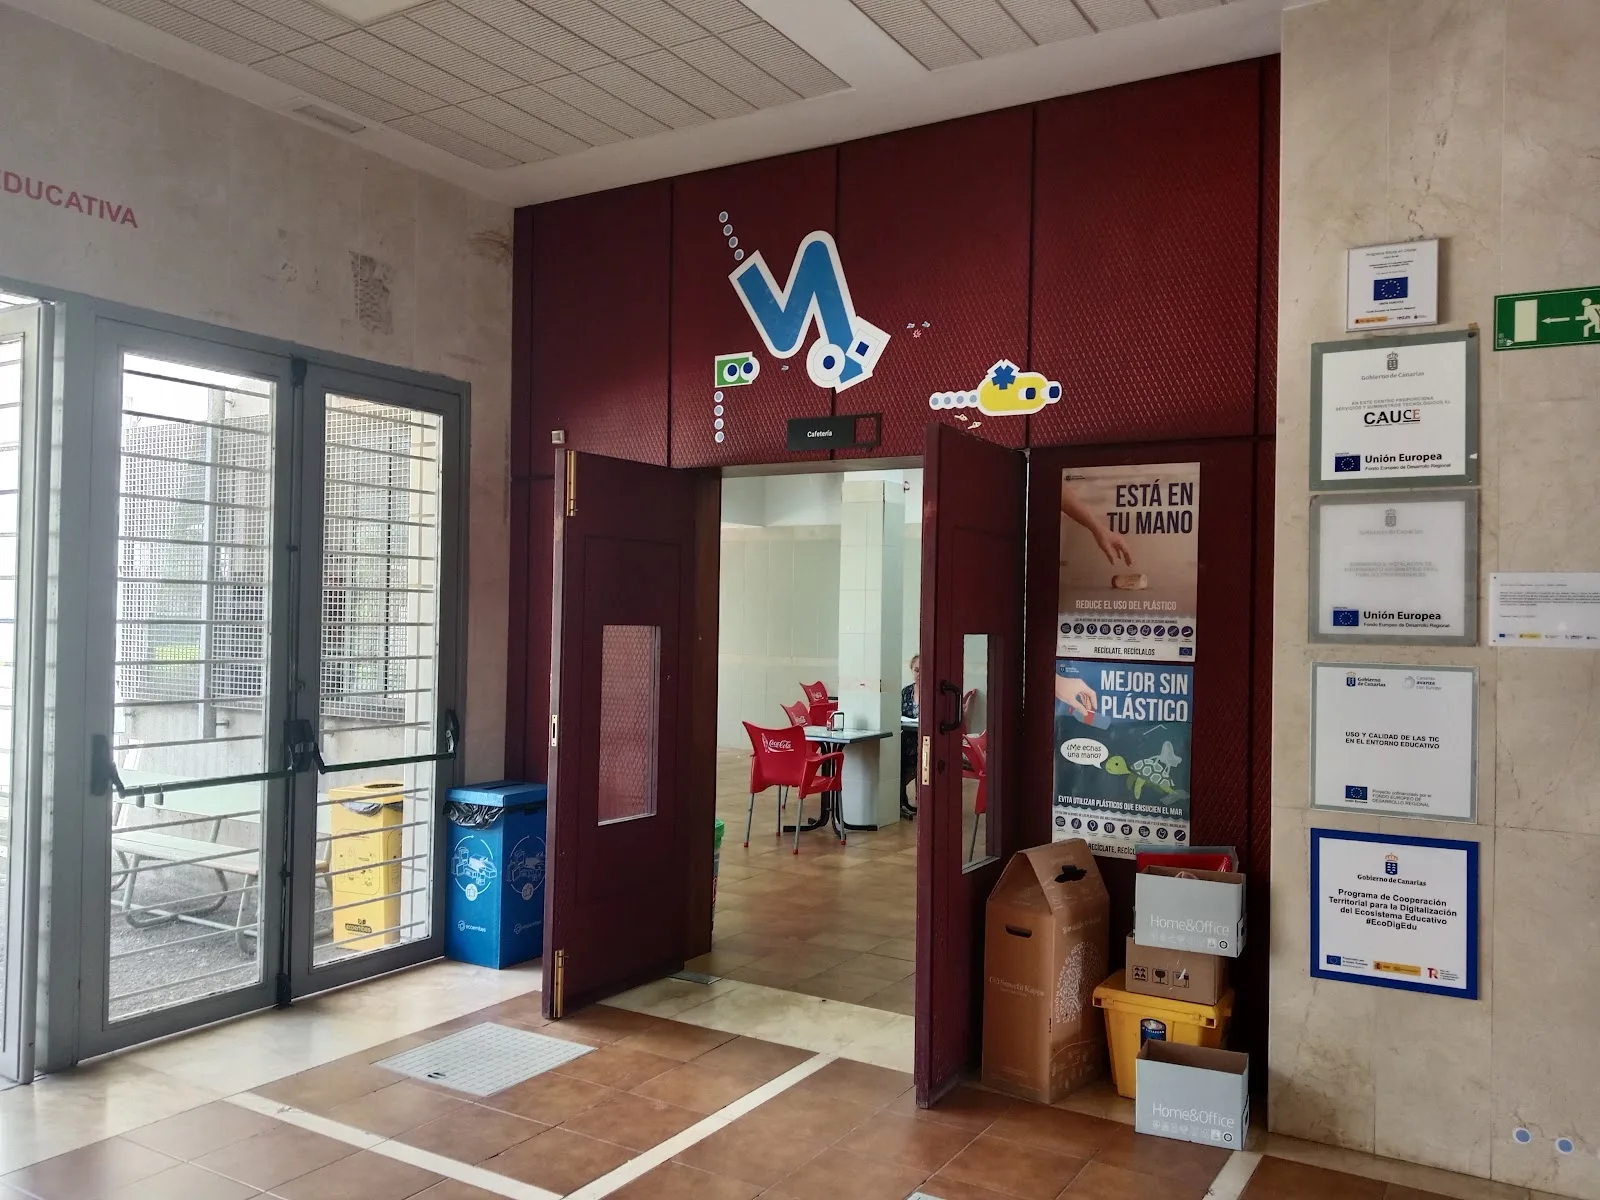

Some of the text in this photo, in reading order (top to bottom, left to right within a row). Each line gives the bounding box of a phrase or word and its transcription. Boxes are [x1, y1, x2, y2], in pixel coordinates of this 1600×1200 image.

[0, 170, 138, 228] DUCATIVA
[1364, 410, 1420, 424] CAUCE
[1365, 453, 1442, 463] Unión Europea
[1116, 479, 1193, 507] ESTÁ EN
[1107, 510, 1193, 534] TU MANO
[1076, 600, 1176, 610] REDUCE EL USO DEL PLÁSTICO
[1364, 611, 1441, 621] Unión Europea
[1124, 647, 1155, 656] RECÍCLALOS
[1101, 670, 1188, 695] MEJOR SIN
[1101, 693, 1188, 722] PLÁSTICO
[1058, 795, 1072, 804] EVITA
[1073, 797, 1095, 806] UTILIZAR
[1096, 799, 1123, 809] PLÁSTICOS
[1124, 803, 1134, 811] QUE
[1135, 804, 1161, 814] ENSUCIEN
[1170, 808, 1182, 816] MAR
[1118, 846, 1136, 855] RECÍCL
[1357, 874, 1388, 882] Gobierno
[1397, 878, 1426, 886] Canarias
[1338, 889, 1378, 899] Programa
[1392, 894, 1446, 906] Cooperación
[1329, 896, 1367, 906] Territorial
[1400, 905, 1457, 917] Digitalización
[1150, 914, 1229, 936] Home&Office
[1355, 908, 1402, 919] Ecosistema
[1405, 914, 1447, 925] Educativo
[1366, 918, 1417, 930] #EcoDigEdu
[1152, 1102, 1234, 1128] Home&Office
